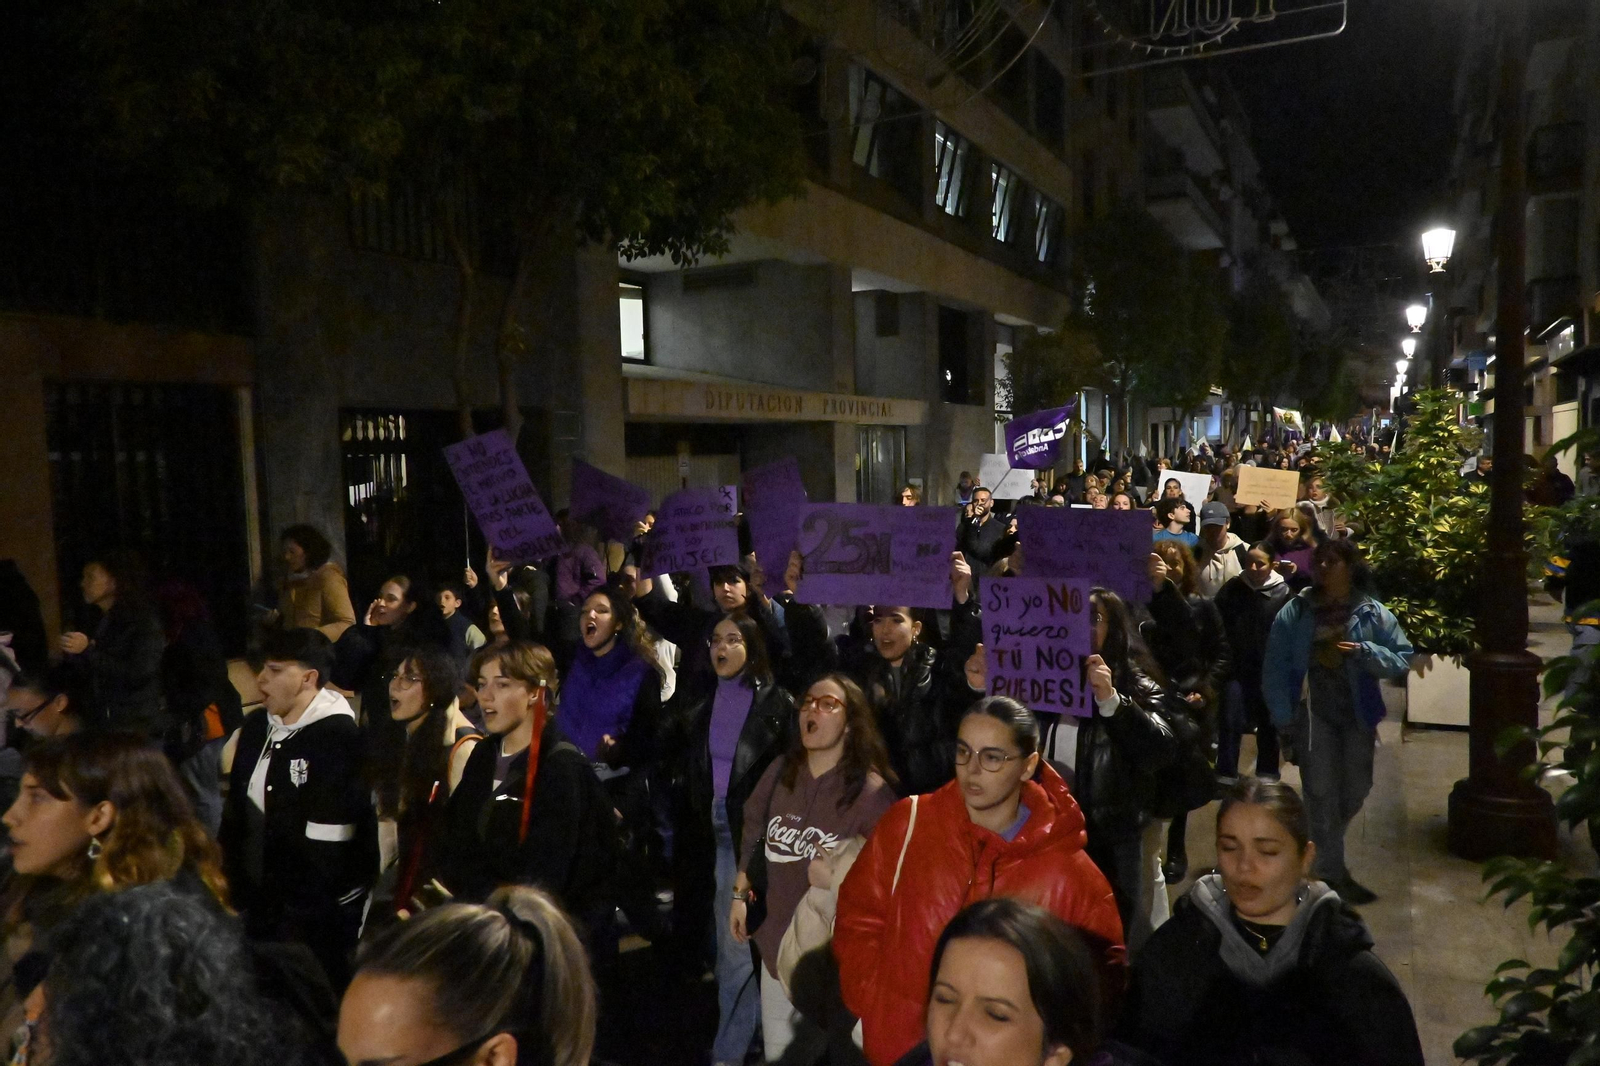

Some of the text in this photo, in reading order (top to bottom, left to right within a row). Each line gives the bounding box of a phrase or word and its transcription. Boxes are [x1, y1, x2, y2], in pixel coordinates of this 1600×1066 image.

[823, 398, 894, 417] PROVINCIAL
[466, 441, 487, 457] NO
[498, 525, 523, 542] DEL
[684, 536, 703, 548] SOY
[802, 509, 892, 575] 25N
[656, 545, 723, 571] MUJER
[988, 583, 1082, 620] Si yo NO
[991, 623, 1069, 645] quiero
[991, 642, 1074, 671] TÚ NO
